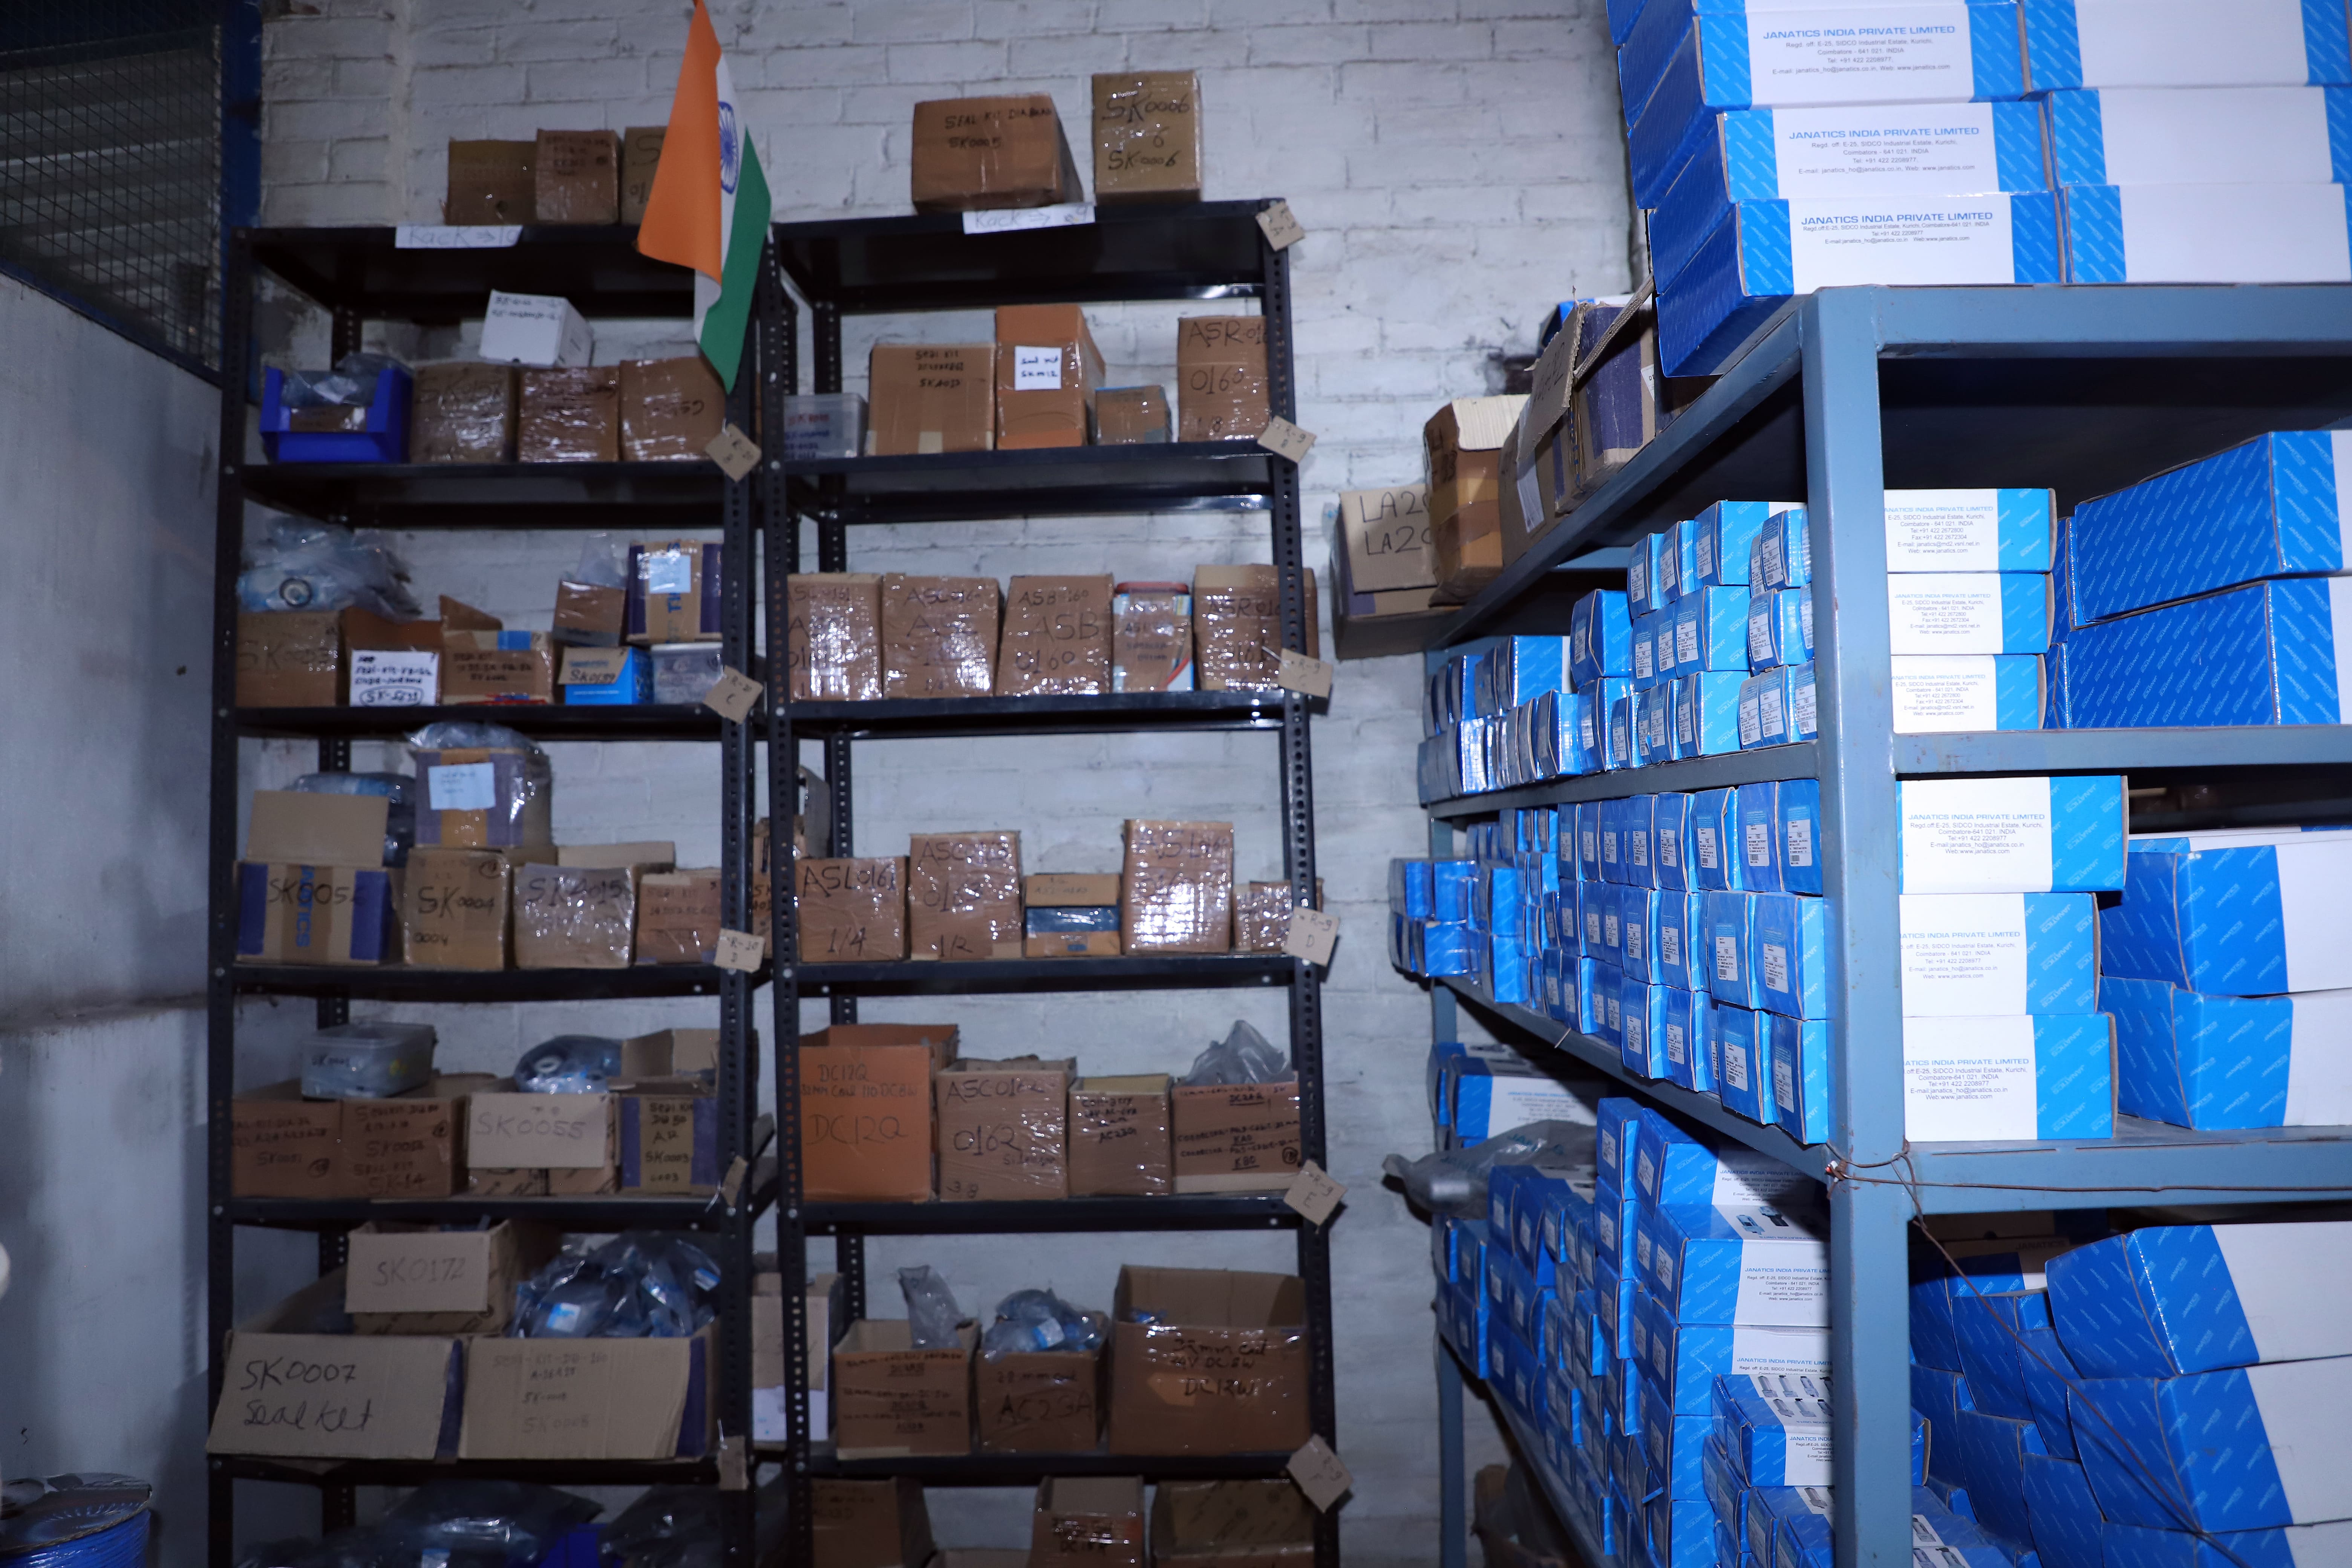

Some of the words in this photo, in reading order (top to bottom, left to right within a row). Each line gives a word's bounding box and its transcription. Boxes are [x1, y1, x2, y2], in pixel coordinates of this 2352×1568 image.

[1763, 30, 1820, 38] JANATICS
[1801, 216, 1858, 224] JANATICS
[1034, 611, 1099, 641] ASB
[1015, 649, 1075, 674] 0160
[477, 1112, 585, 1139] SK0055
[807, 1113, 909, 1146] DC12Q
[953, 1125, 1021, 1156] 0162
[2015, 1239, 2066, 1251] JANATICS
[241, 1357, 357, 1391] SK0007
